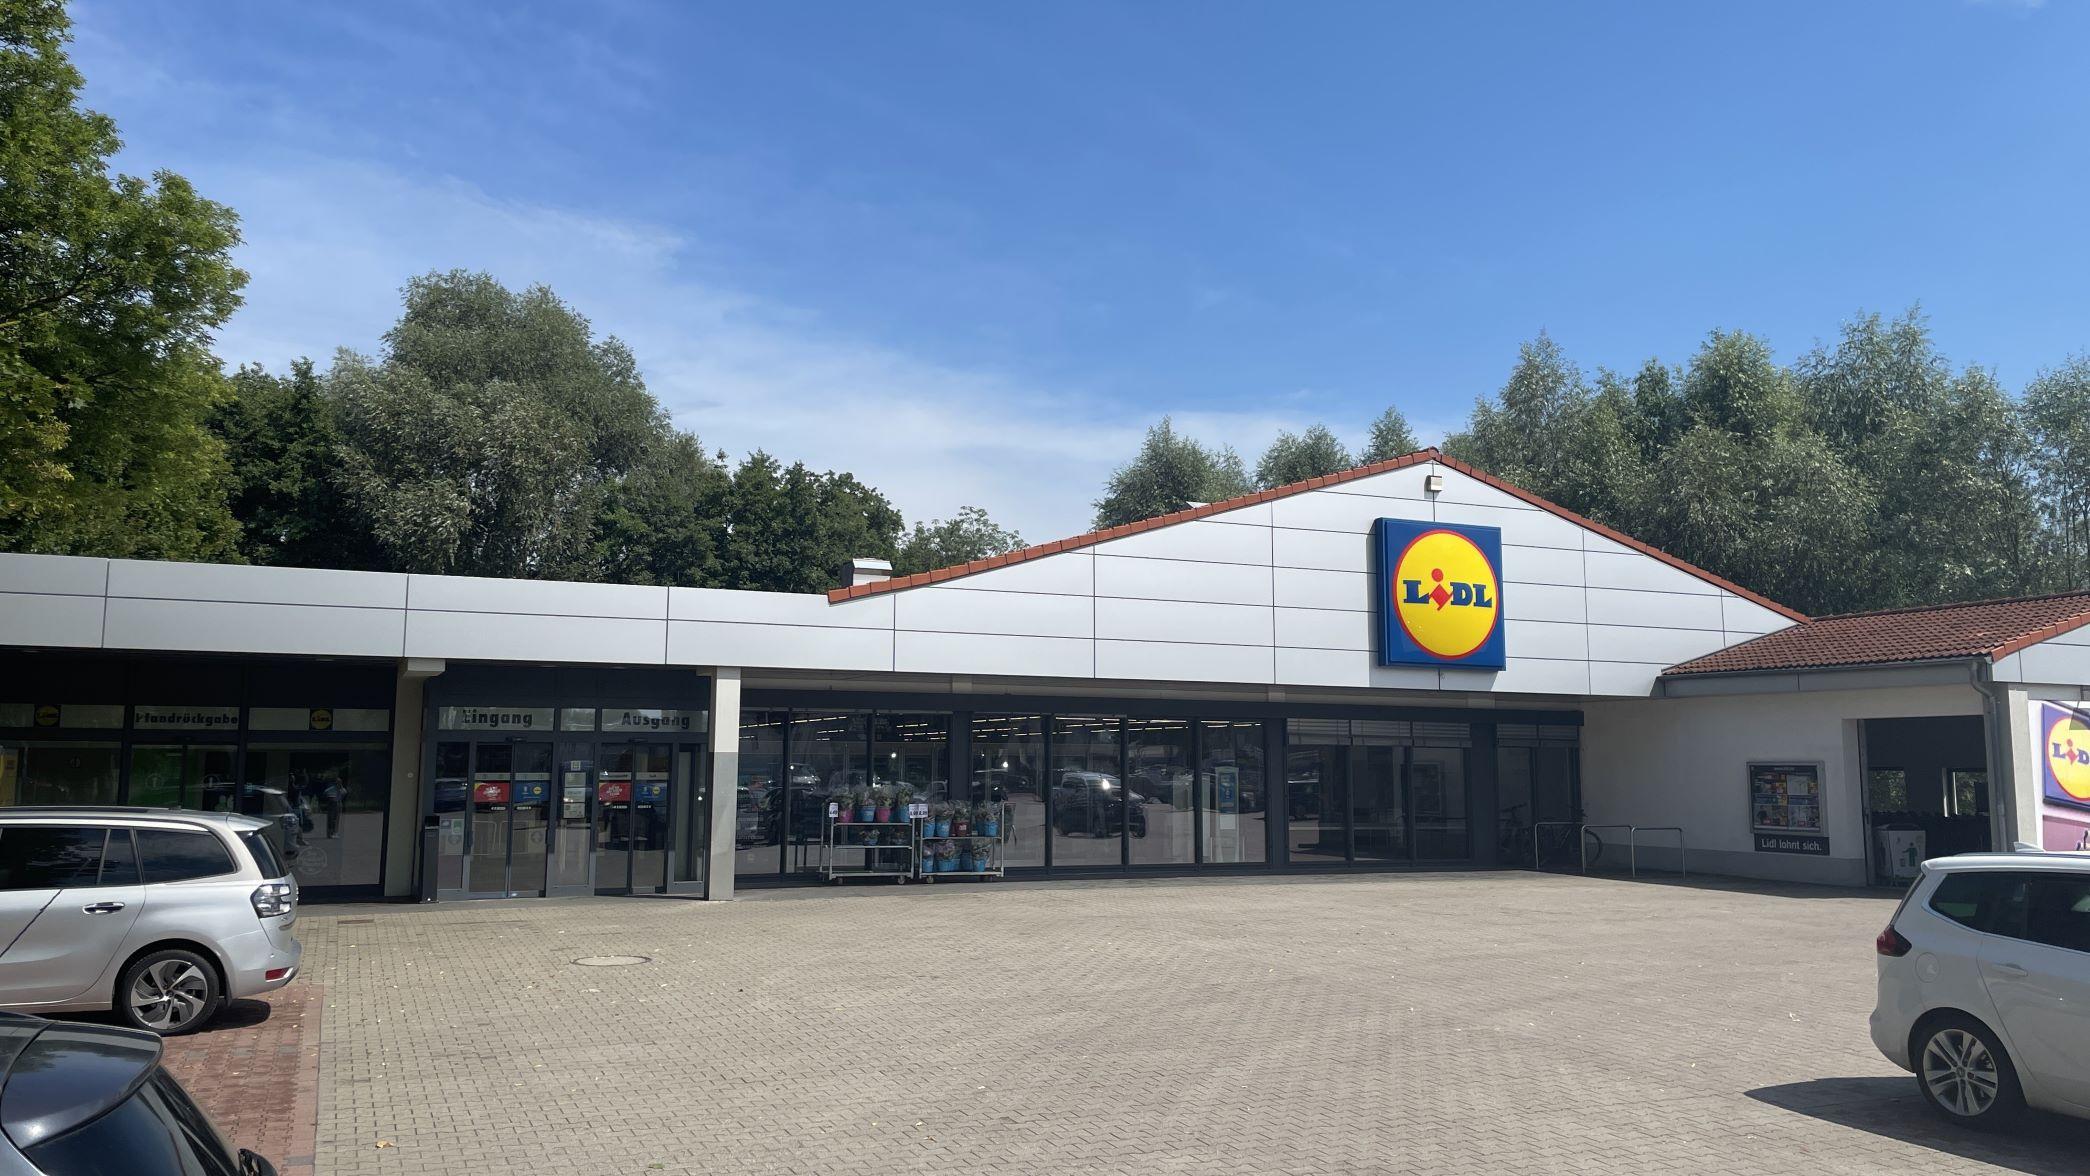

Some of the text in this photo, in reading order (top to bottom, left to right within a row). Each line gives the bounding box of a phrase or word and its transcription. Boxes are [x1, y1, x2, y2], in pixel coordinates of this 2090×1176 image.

[1403, 568, 1492, 611] LIDL
[136, 712, 238, 726] Pfandrückgabe
[463, 708, 533, 728] Eingang
[622, 711, 690, 729] Ausgang
[2052, 738, 2090, 766] LID
[1761, 838, 1823, 851] Lidl lohnt sich.
